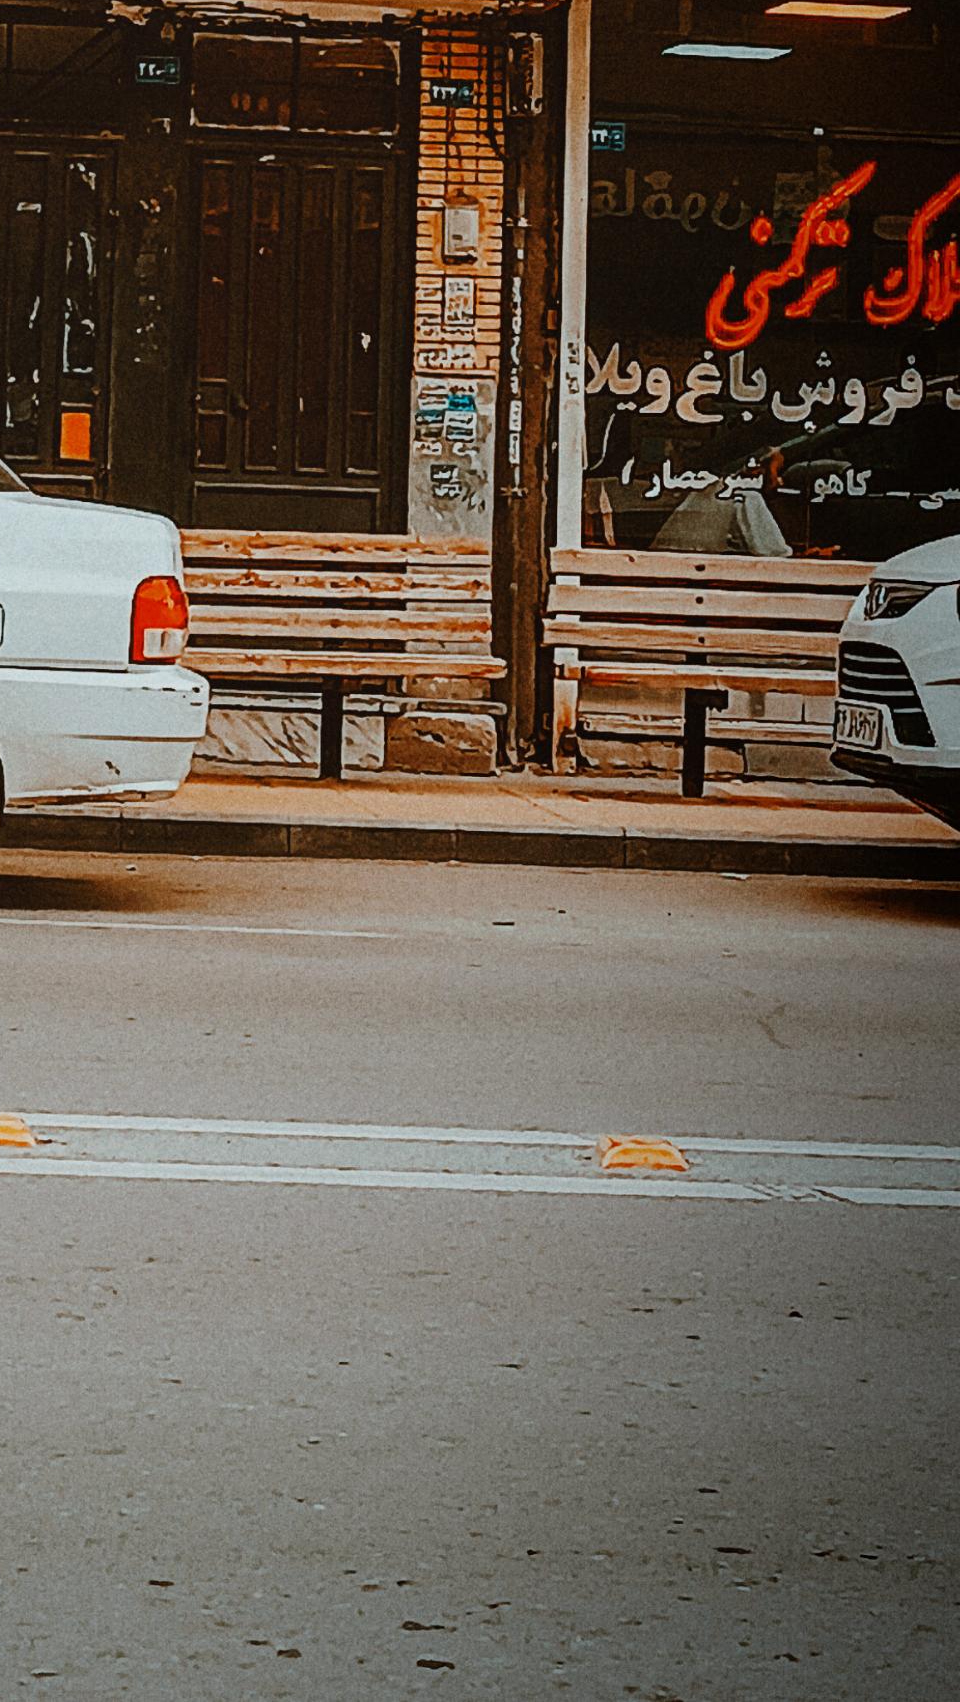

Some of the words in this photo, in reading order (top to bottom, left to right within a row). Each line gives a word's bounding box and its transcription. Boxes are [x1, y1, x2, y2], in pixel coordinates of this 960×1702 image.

[587, 343, 671, 414] ویلا
[676, 350, 768, 423] باغ
[772, 352, 923, 426] فروش
[811, 468, 872, 503] کاهو
